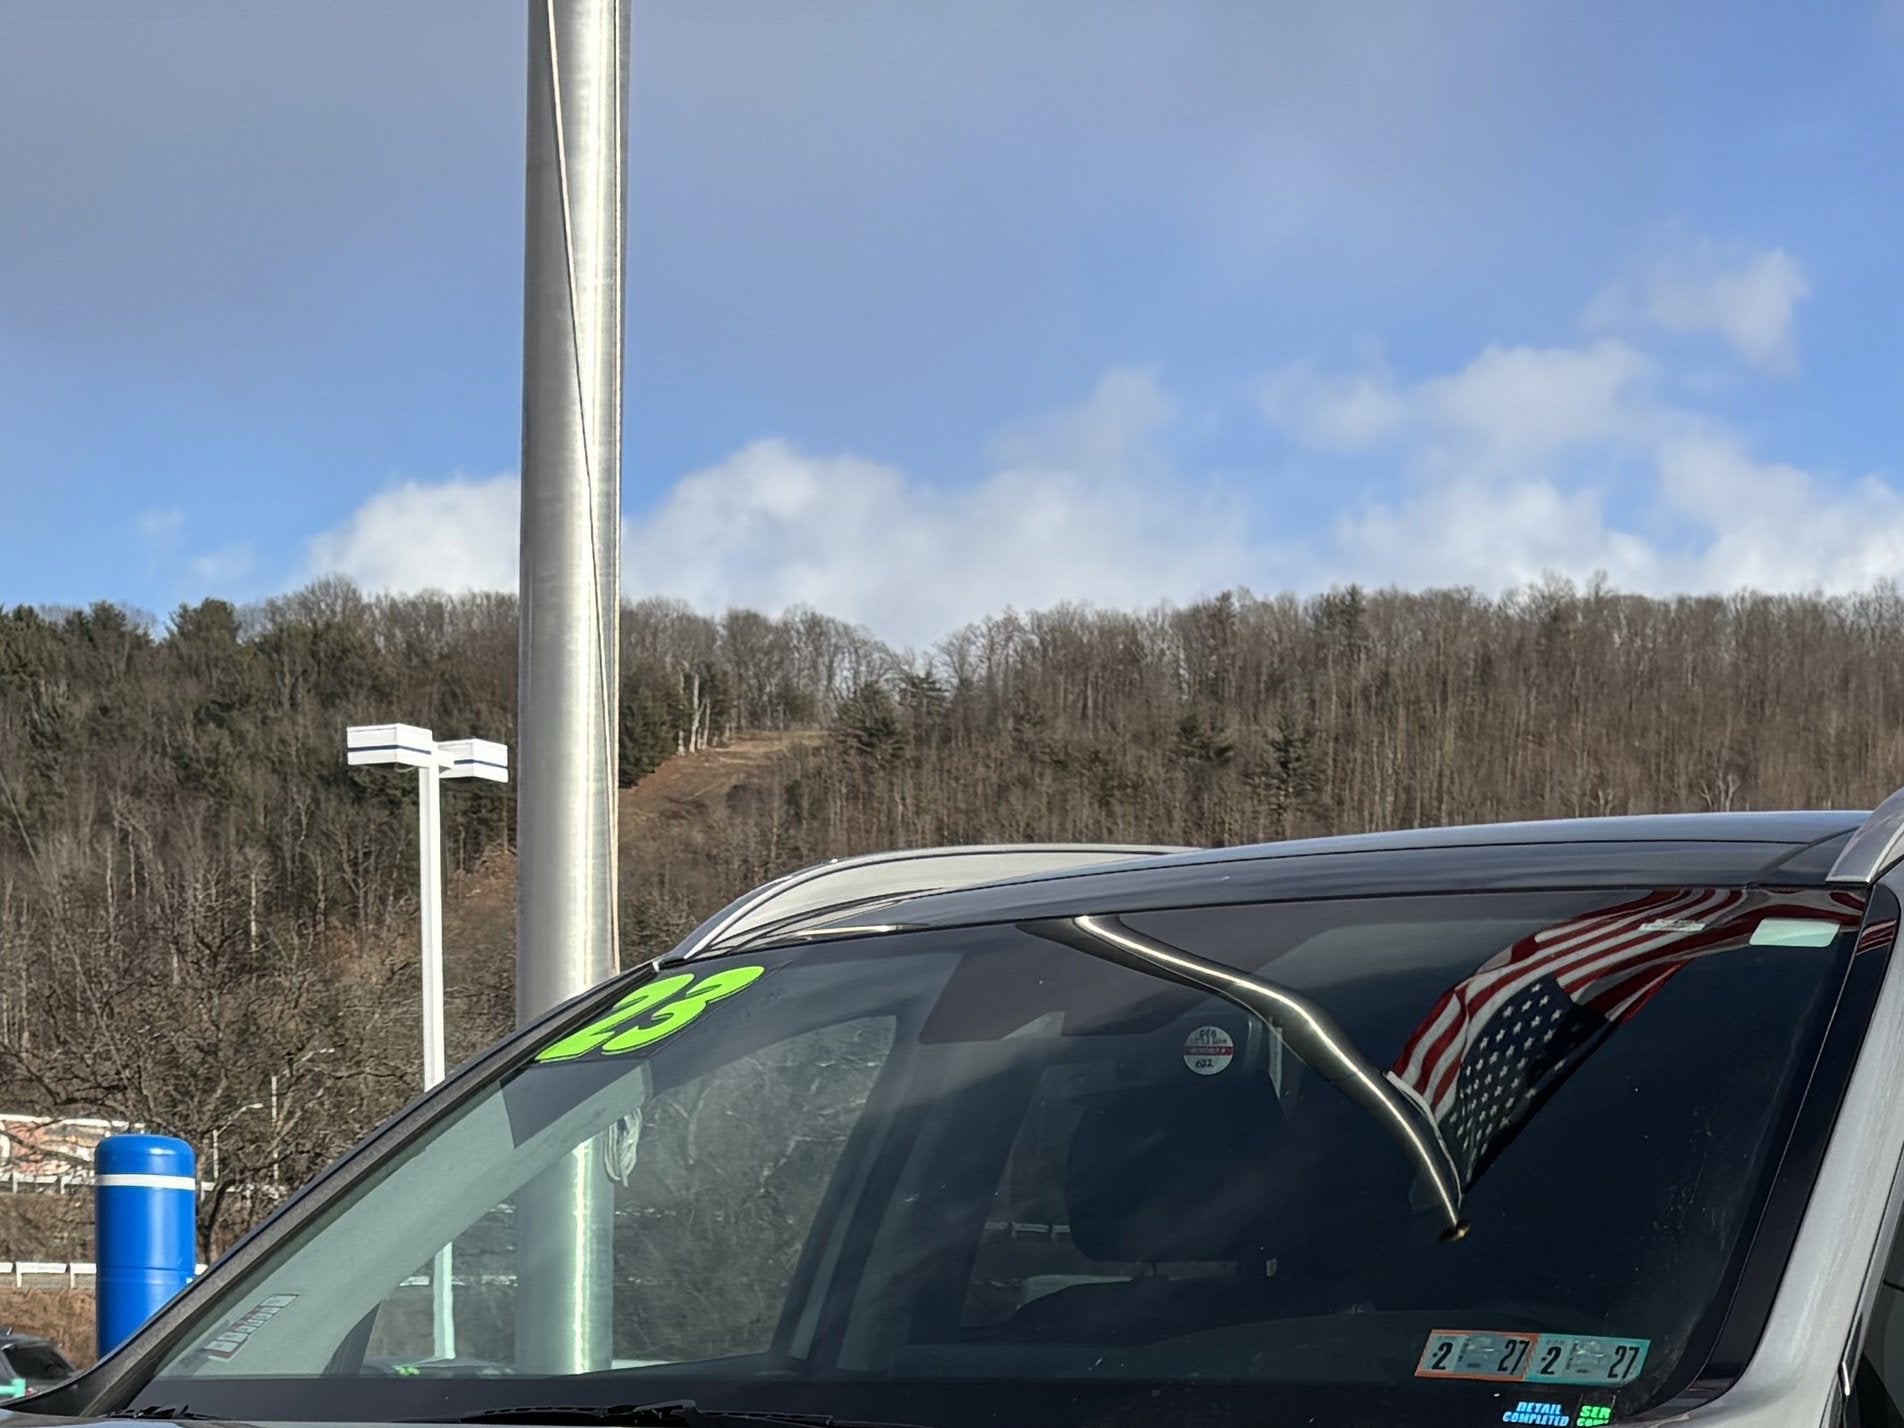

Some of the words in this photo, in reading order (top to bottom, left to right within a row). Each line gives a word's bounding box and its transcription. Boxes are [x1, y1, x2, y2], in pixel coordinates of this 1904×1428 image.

[534, 964, 766, 1064] 23
[1497, 1339, 1531, 1376] 27
[1607, 1345, 1641, 1380] 27
[1502, 1411, 1570, 1427] COMPLETED
[1516, 1401, 1562, 1415] DETAIL
